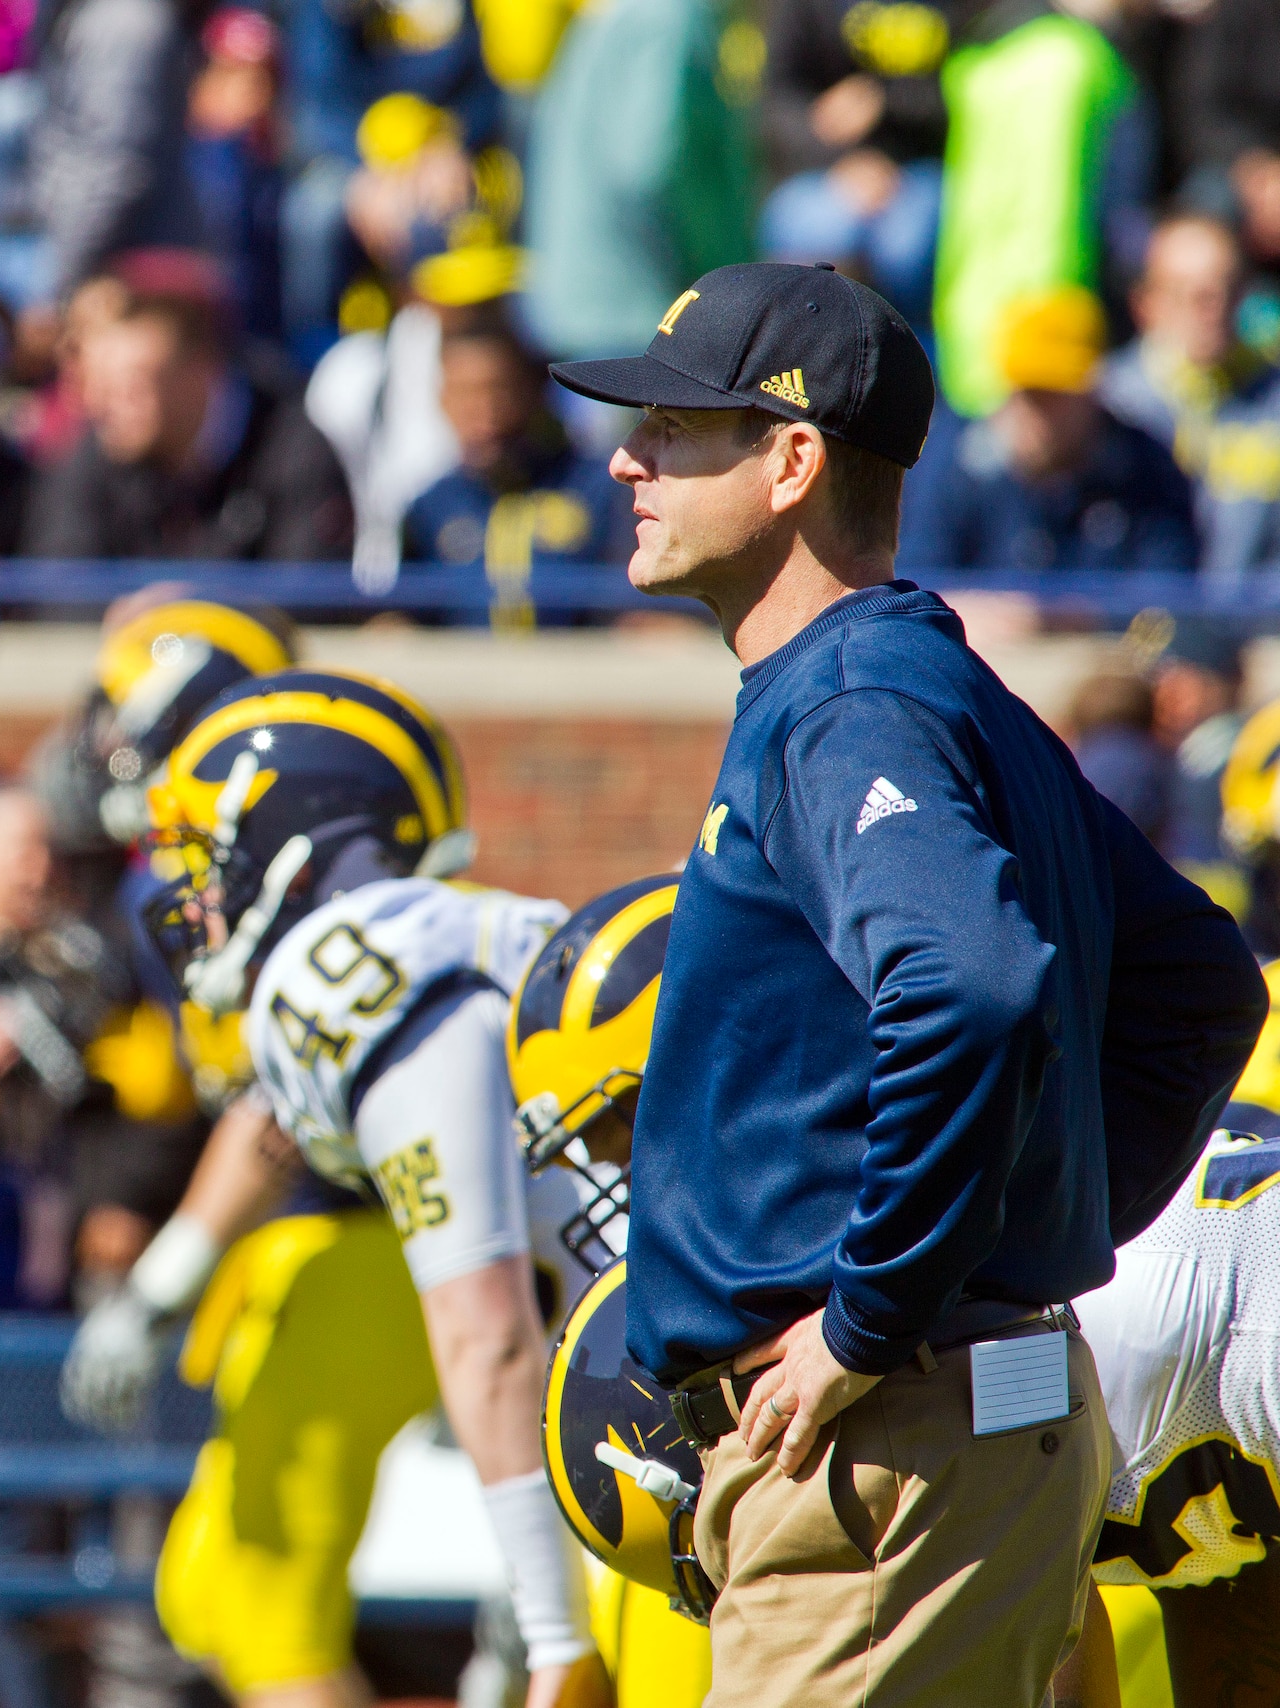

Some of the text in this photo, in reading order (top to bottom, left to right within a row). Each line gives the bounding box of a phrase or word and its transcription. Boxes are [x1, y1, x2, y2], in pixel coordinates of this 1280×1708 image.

[759, 380, 810, 409] adidas
[856, 798, 919, 835] adidas
[268, 922, 408, 1070] 49
